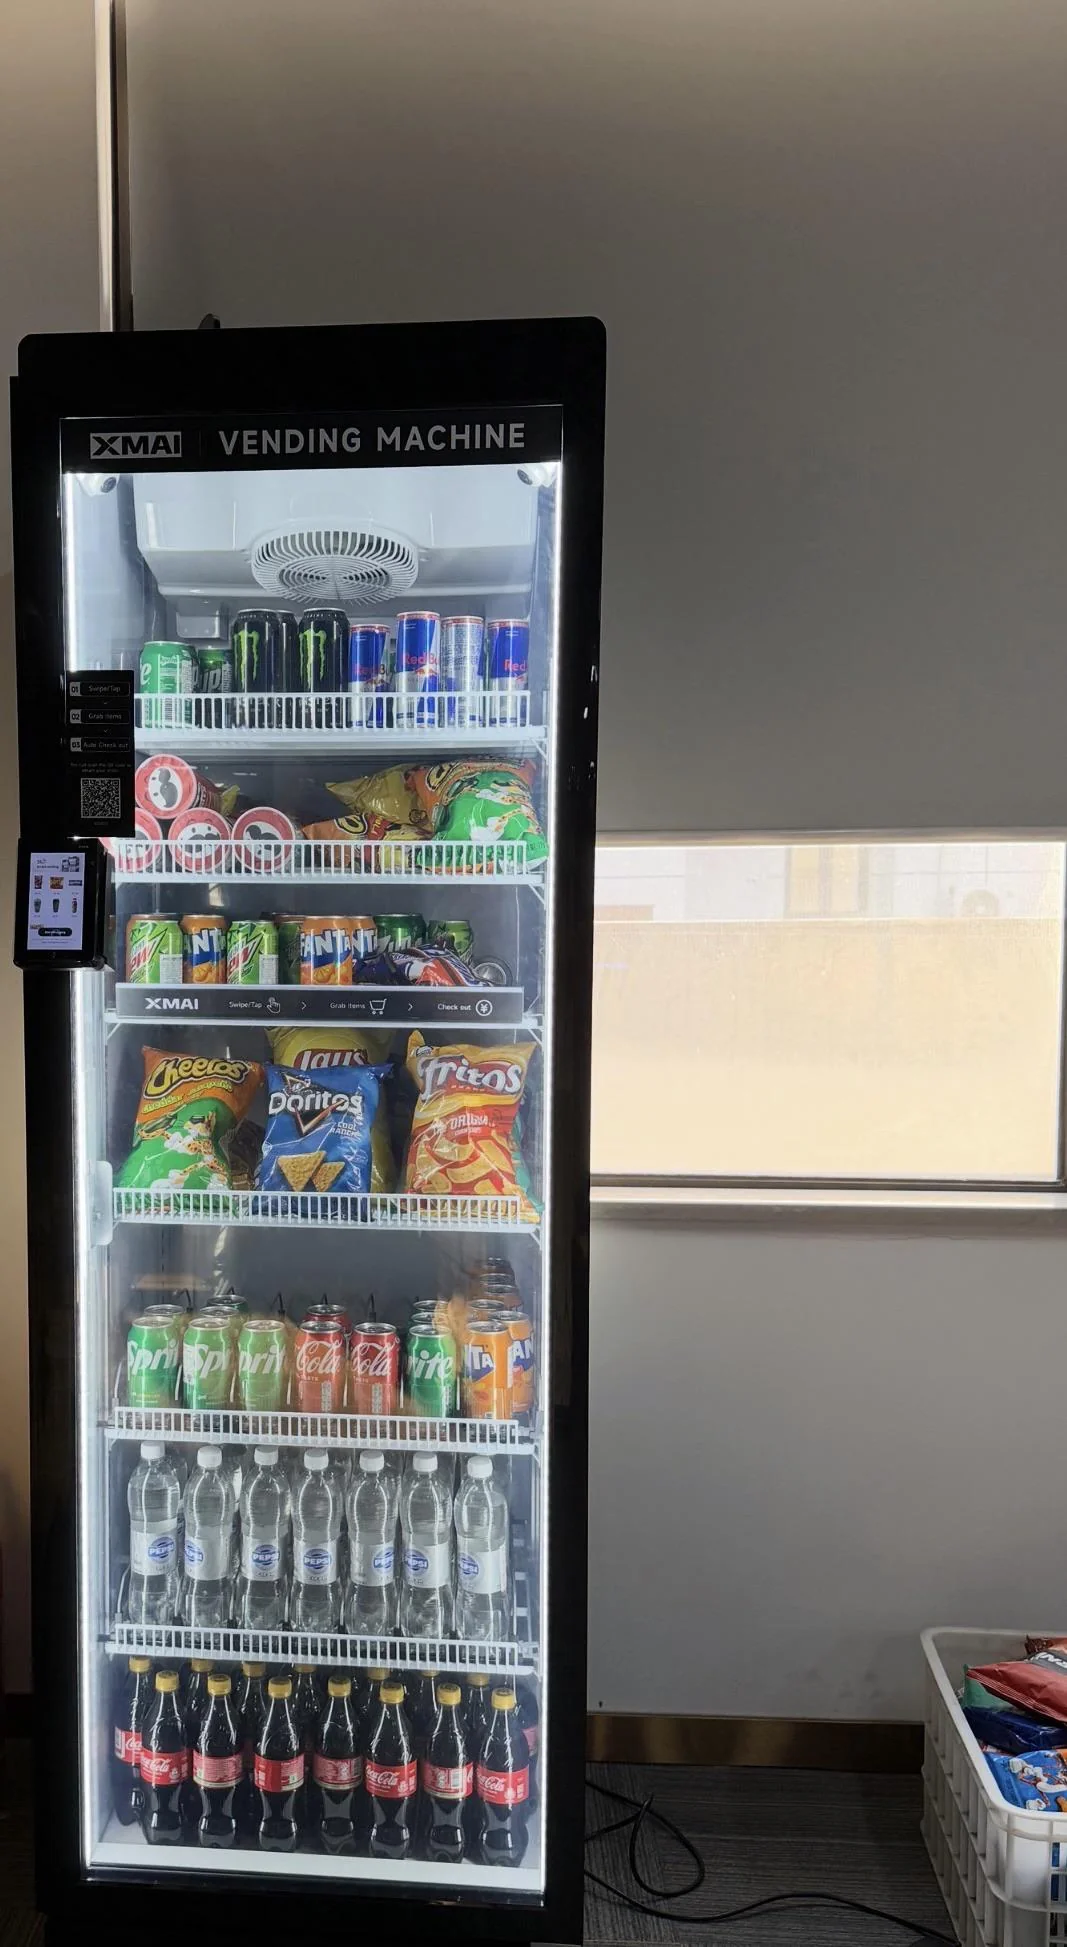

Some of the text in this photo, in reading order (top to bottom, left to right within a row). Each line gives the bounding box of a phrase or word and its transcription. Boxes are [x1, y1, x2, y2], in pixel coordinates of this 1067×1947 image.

[91, 433, 182, 457] XMAI
[218, 423, 525, 456] VENDING MACHINE
[144, 998, 199, 1010] XMAI
[330, 1002, 346, 1010] Grab
[437, 1003, 457, 1011] Check
[144, 1057, 247, 1097] Cheetos
[416, 1057, 522, 1102] Fritos
[269, 1091, 363, 1115] Doritos
